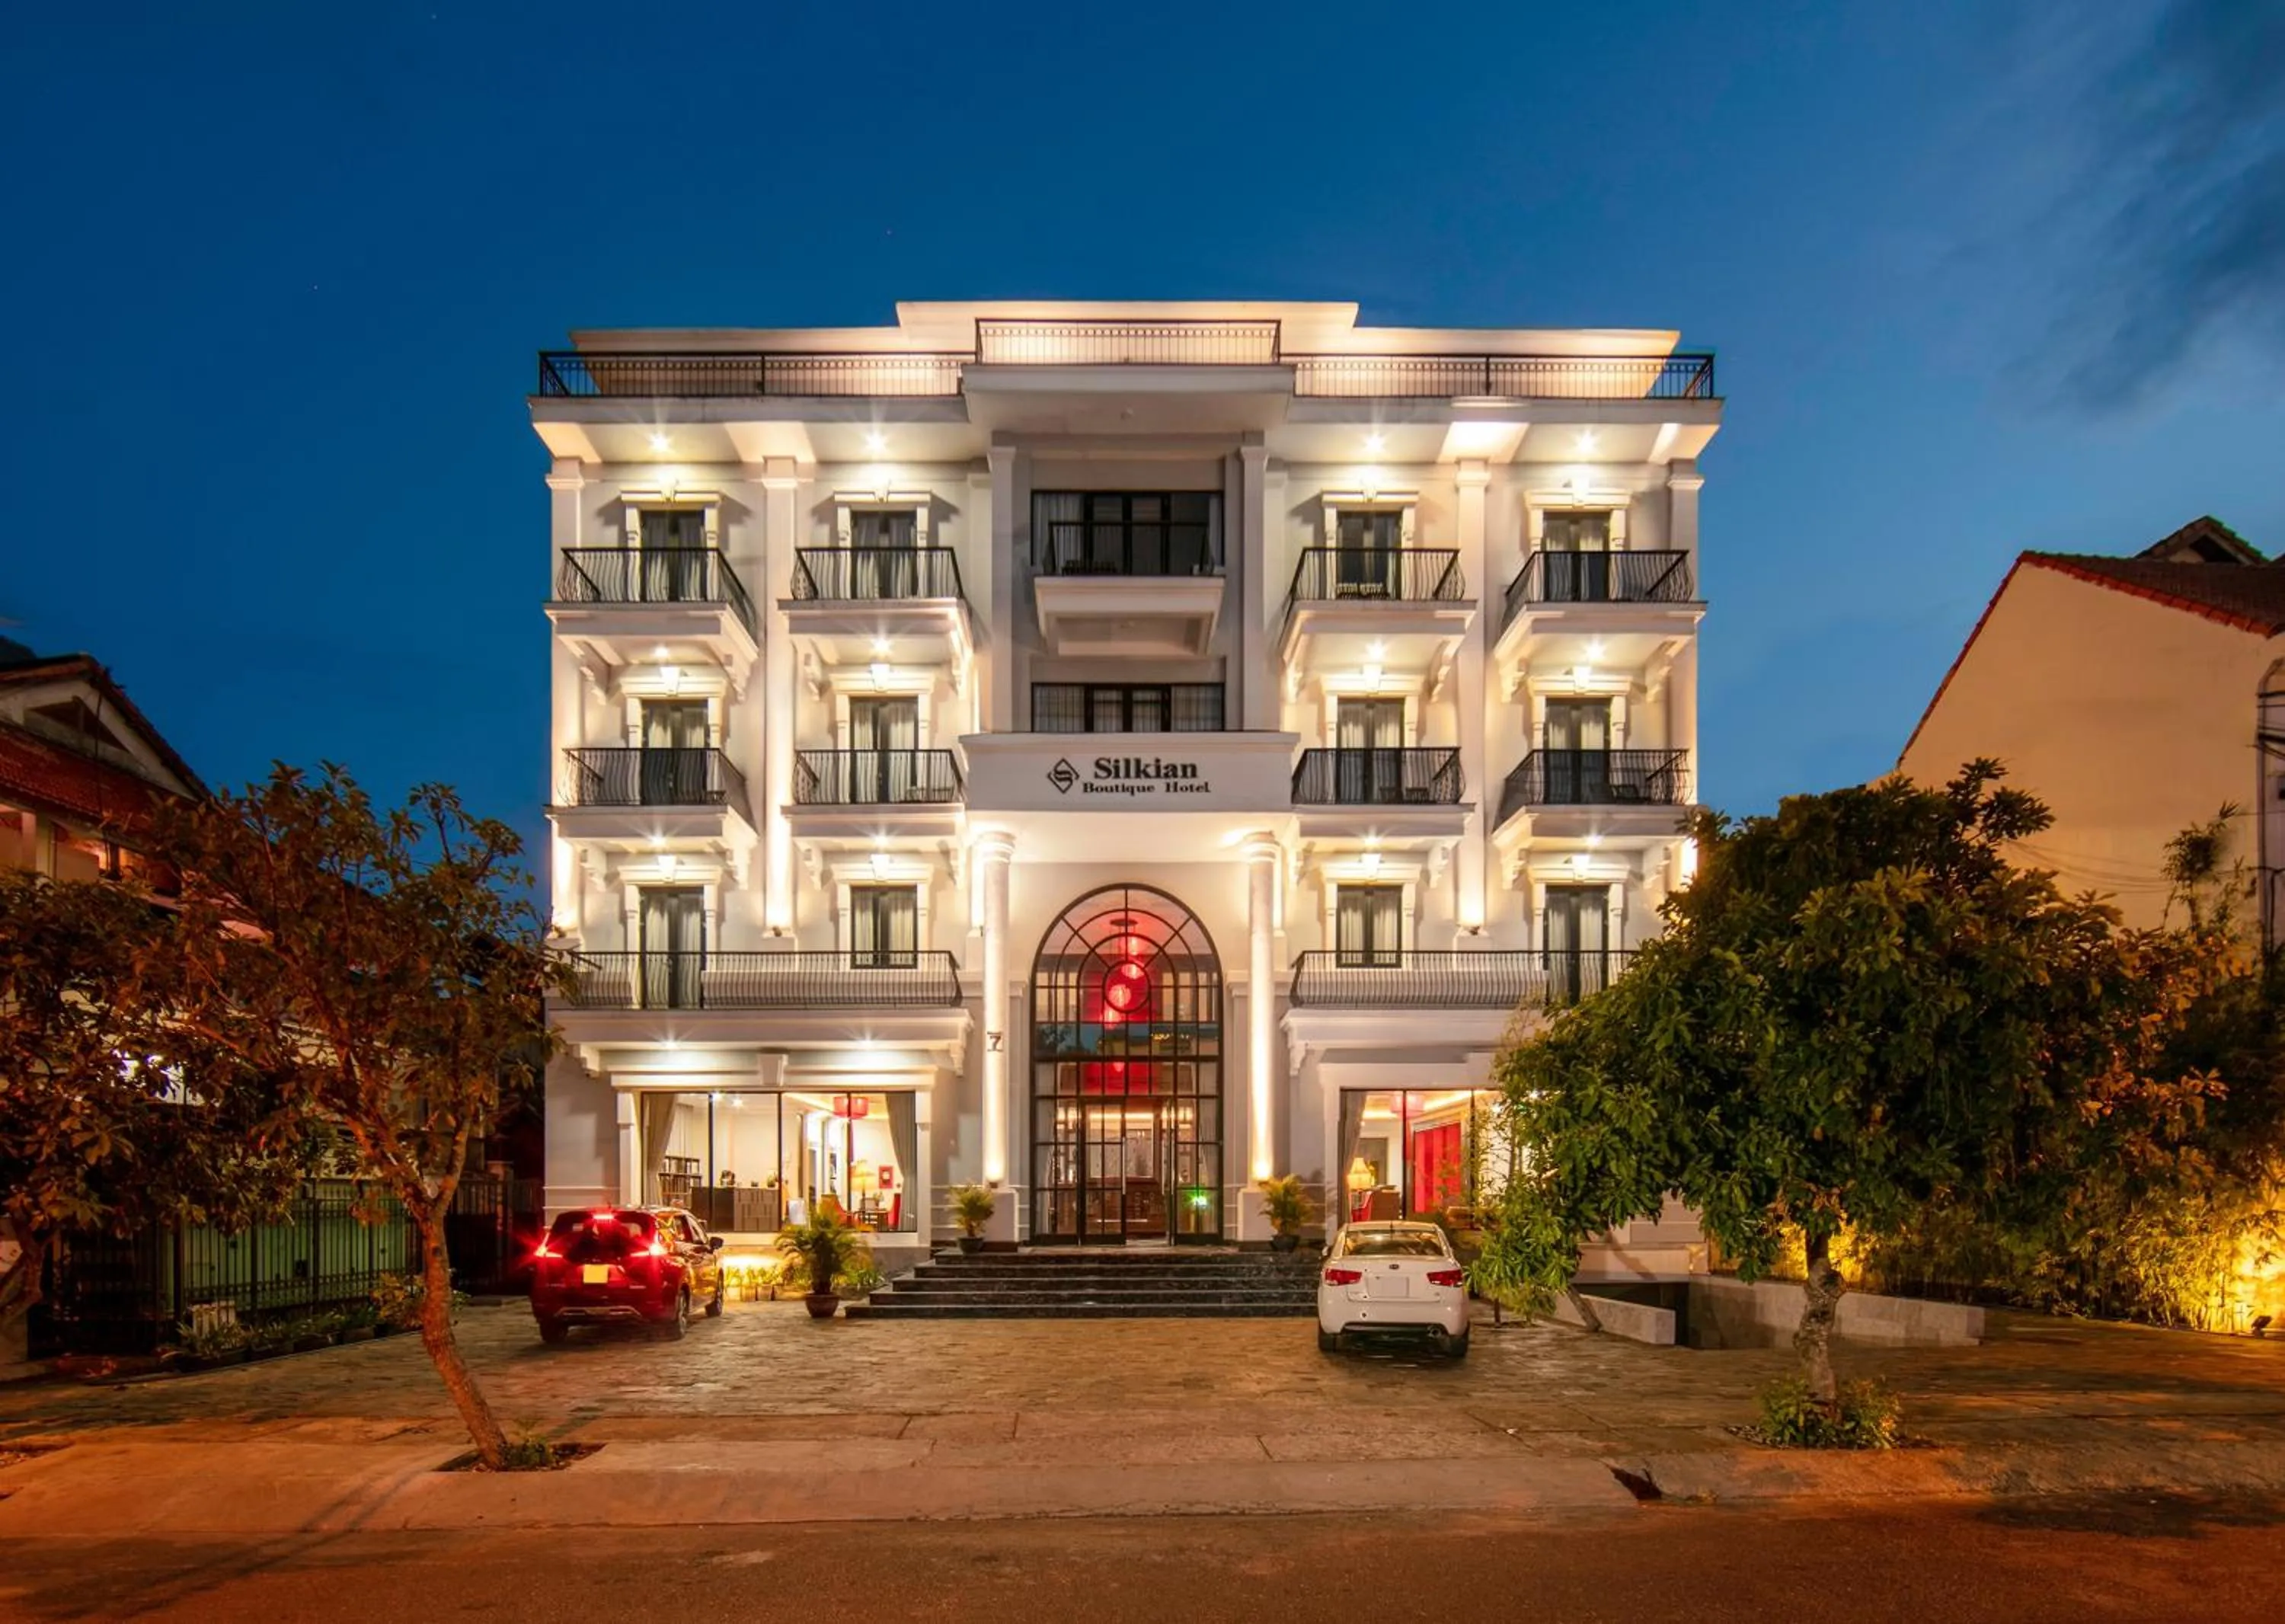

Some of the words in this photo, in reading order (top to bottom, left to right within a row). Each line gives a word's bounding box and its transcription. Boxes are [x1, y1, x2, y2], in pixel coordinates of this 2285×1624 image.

[1094, 757, 1197, 778] Silkian
[1082, 782, 1155, 796] Boutique
[1165, 782, 1211, 792] Hotel
